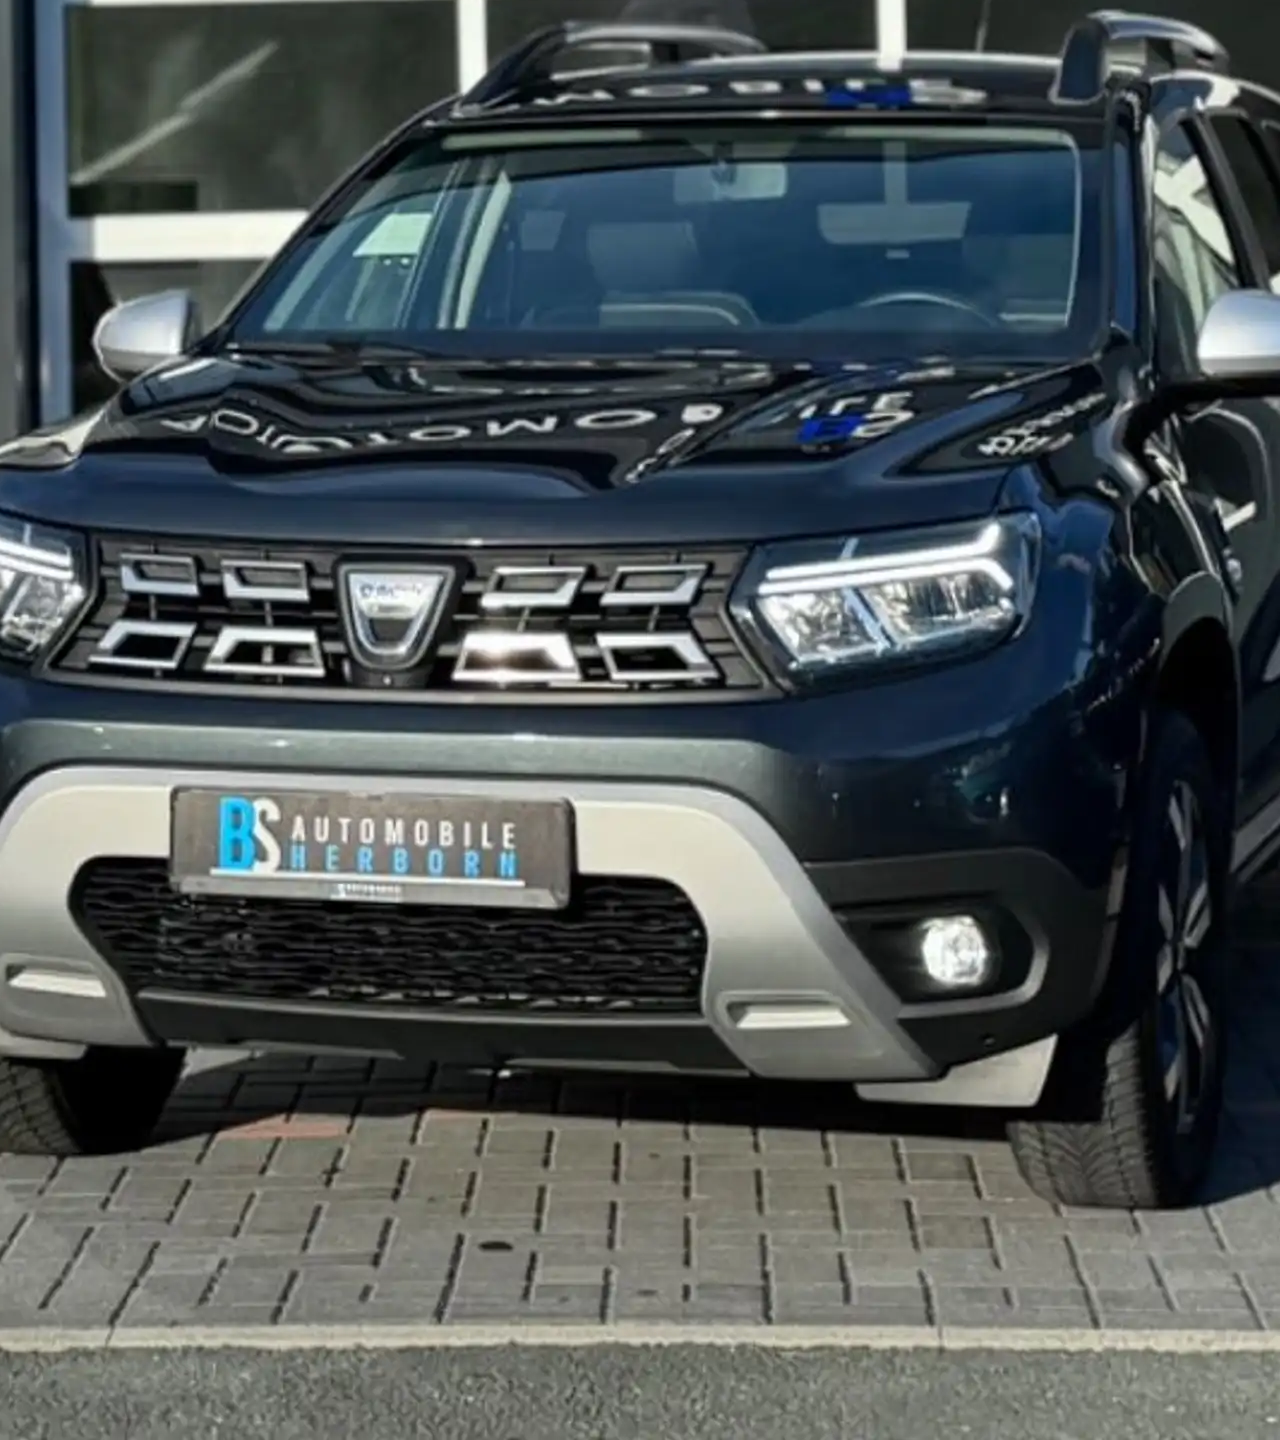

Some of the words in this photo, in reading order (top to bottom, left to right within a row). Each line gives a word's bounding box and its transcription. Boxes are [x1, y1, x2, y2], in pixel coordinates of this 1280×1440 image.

[218, 795, 282, 873] BS
[289, 815, 517, 851] AUTOMOBILE
[289, 844, 518, 879] HERBORN
